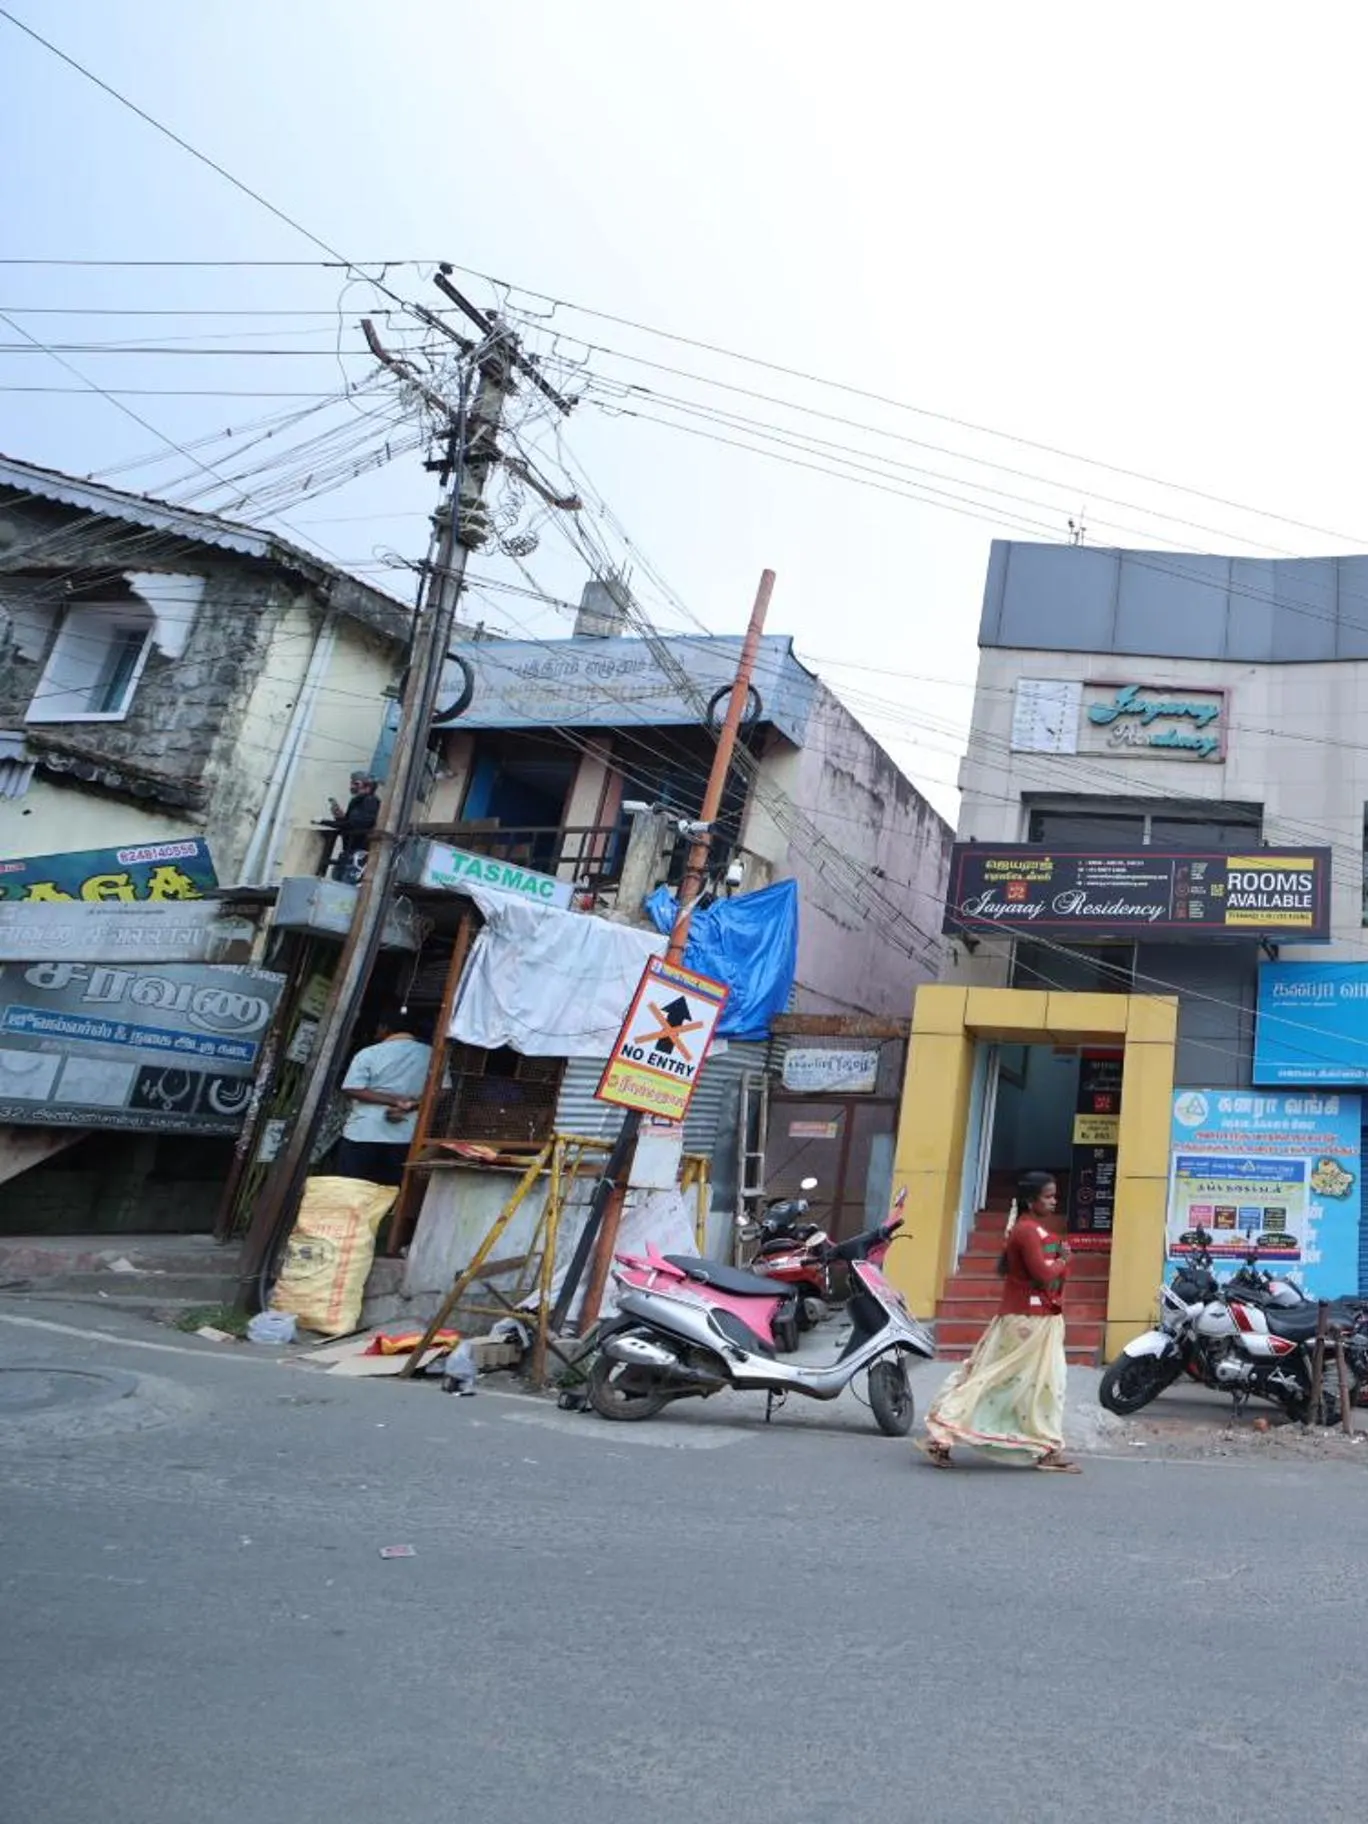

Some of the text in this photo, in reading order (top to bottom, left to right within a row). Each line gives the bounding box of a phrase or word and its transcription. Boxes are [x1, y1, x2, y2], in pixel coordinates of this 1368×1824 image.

[451, 851, 555, 898] TASMAC
[1227, 872, 1312, 891] ROOMS
[961, 888, 1047, 920] Jayaraj
[1052, 889, 1166, 922] Residency
[1227, 894, 1312, 907] AVAILABLE
[113, 1025, 127, 1041] &
[621, 1044, 696, 1078] NO ENTRY
